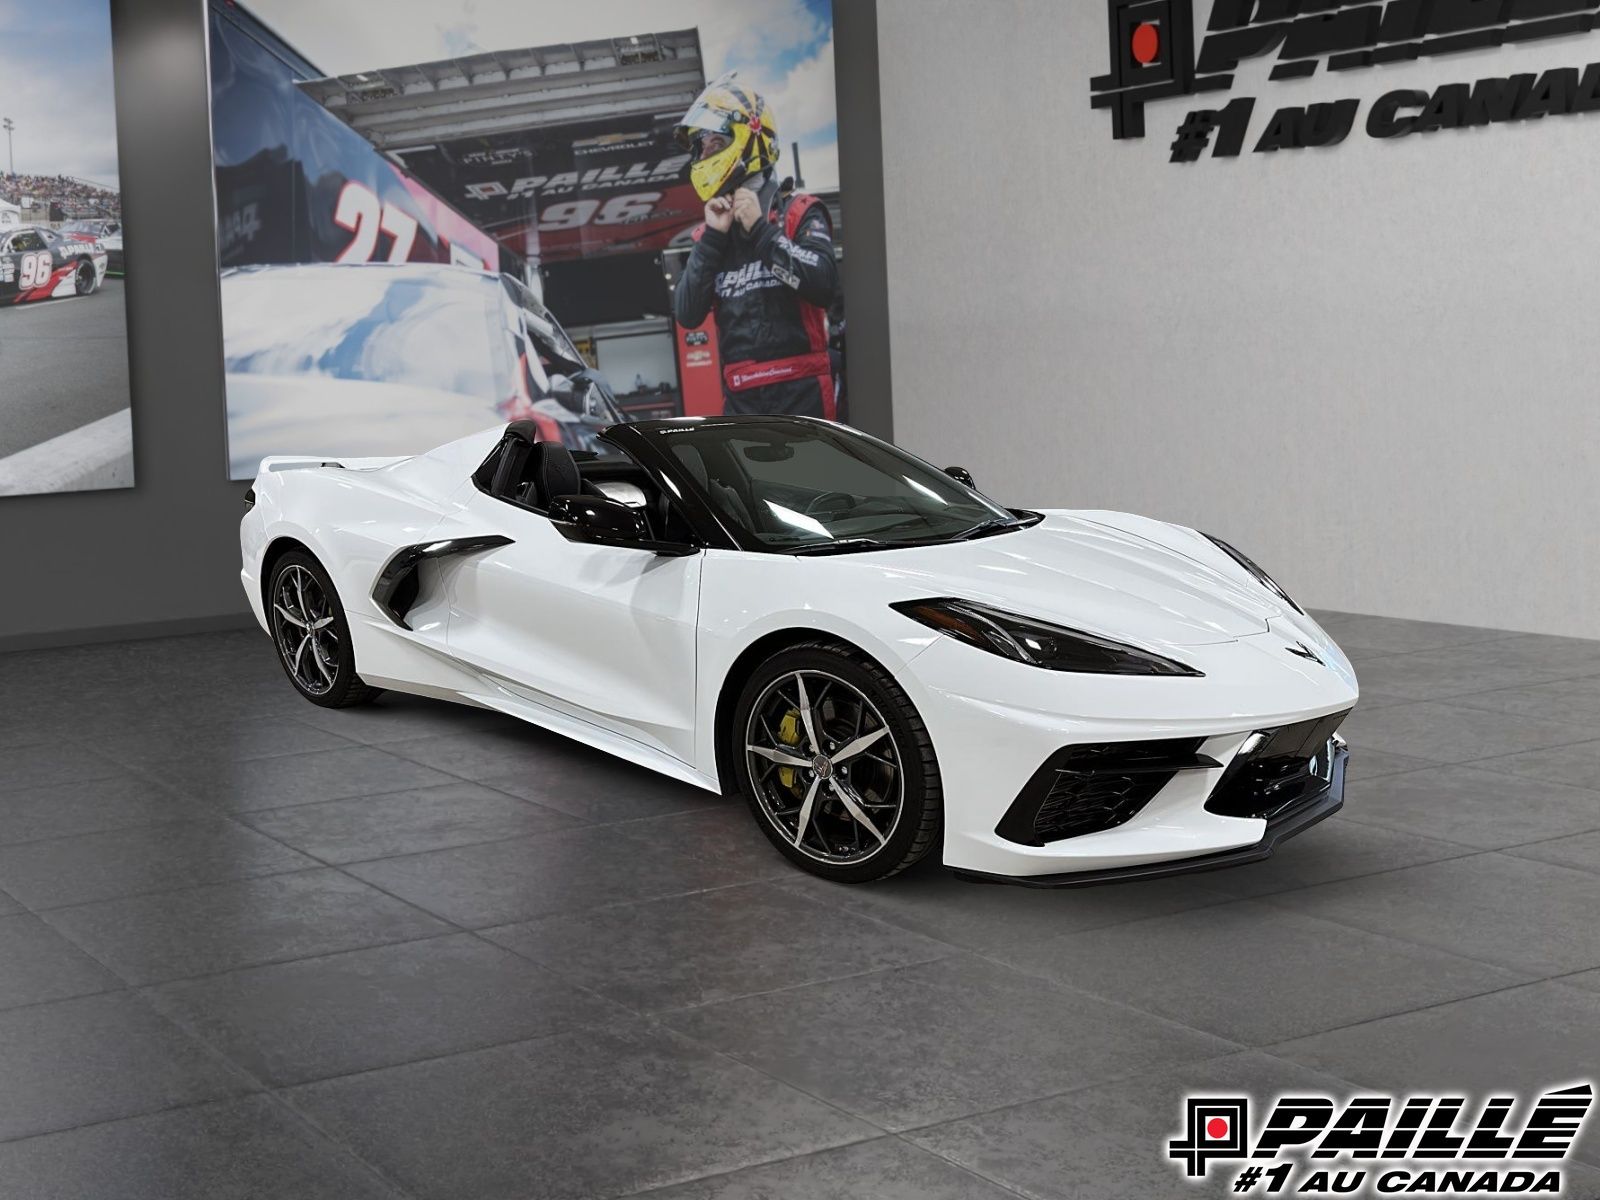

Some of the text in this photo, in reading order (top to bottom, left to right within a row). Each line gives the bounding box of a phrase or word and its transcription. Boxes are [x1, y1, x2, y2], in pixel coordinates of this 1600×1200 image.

[574, 141, 654, 156] CHEVROLET
[1169, 97, 1257, 163] #1
[1254, 99, 1360, 153] AU
[541, 185, 575, 197] AU
[582, 173, 679, 191] CANADA
[333, 179, 418, 264] 27
[537, 191, 663, 232] 96
[19, 251, 53, 290] 96
